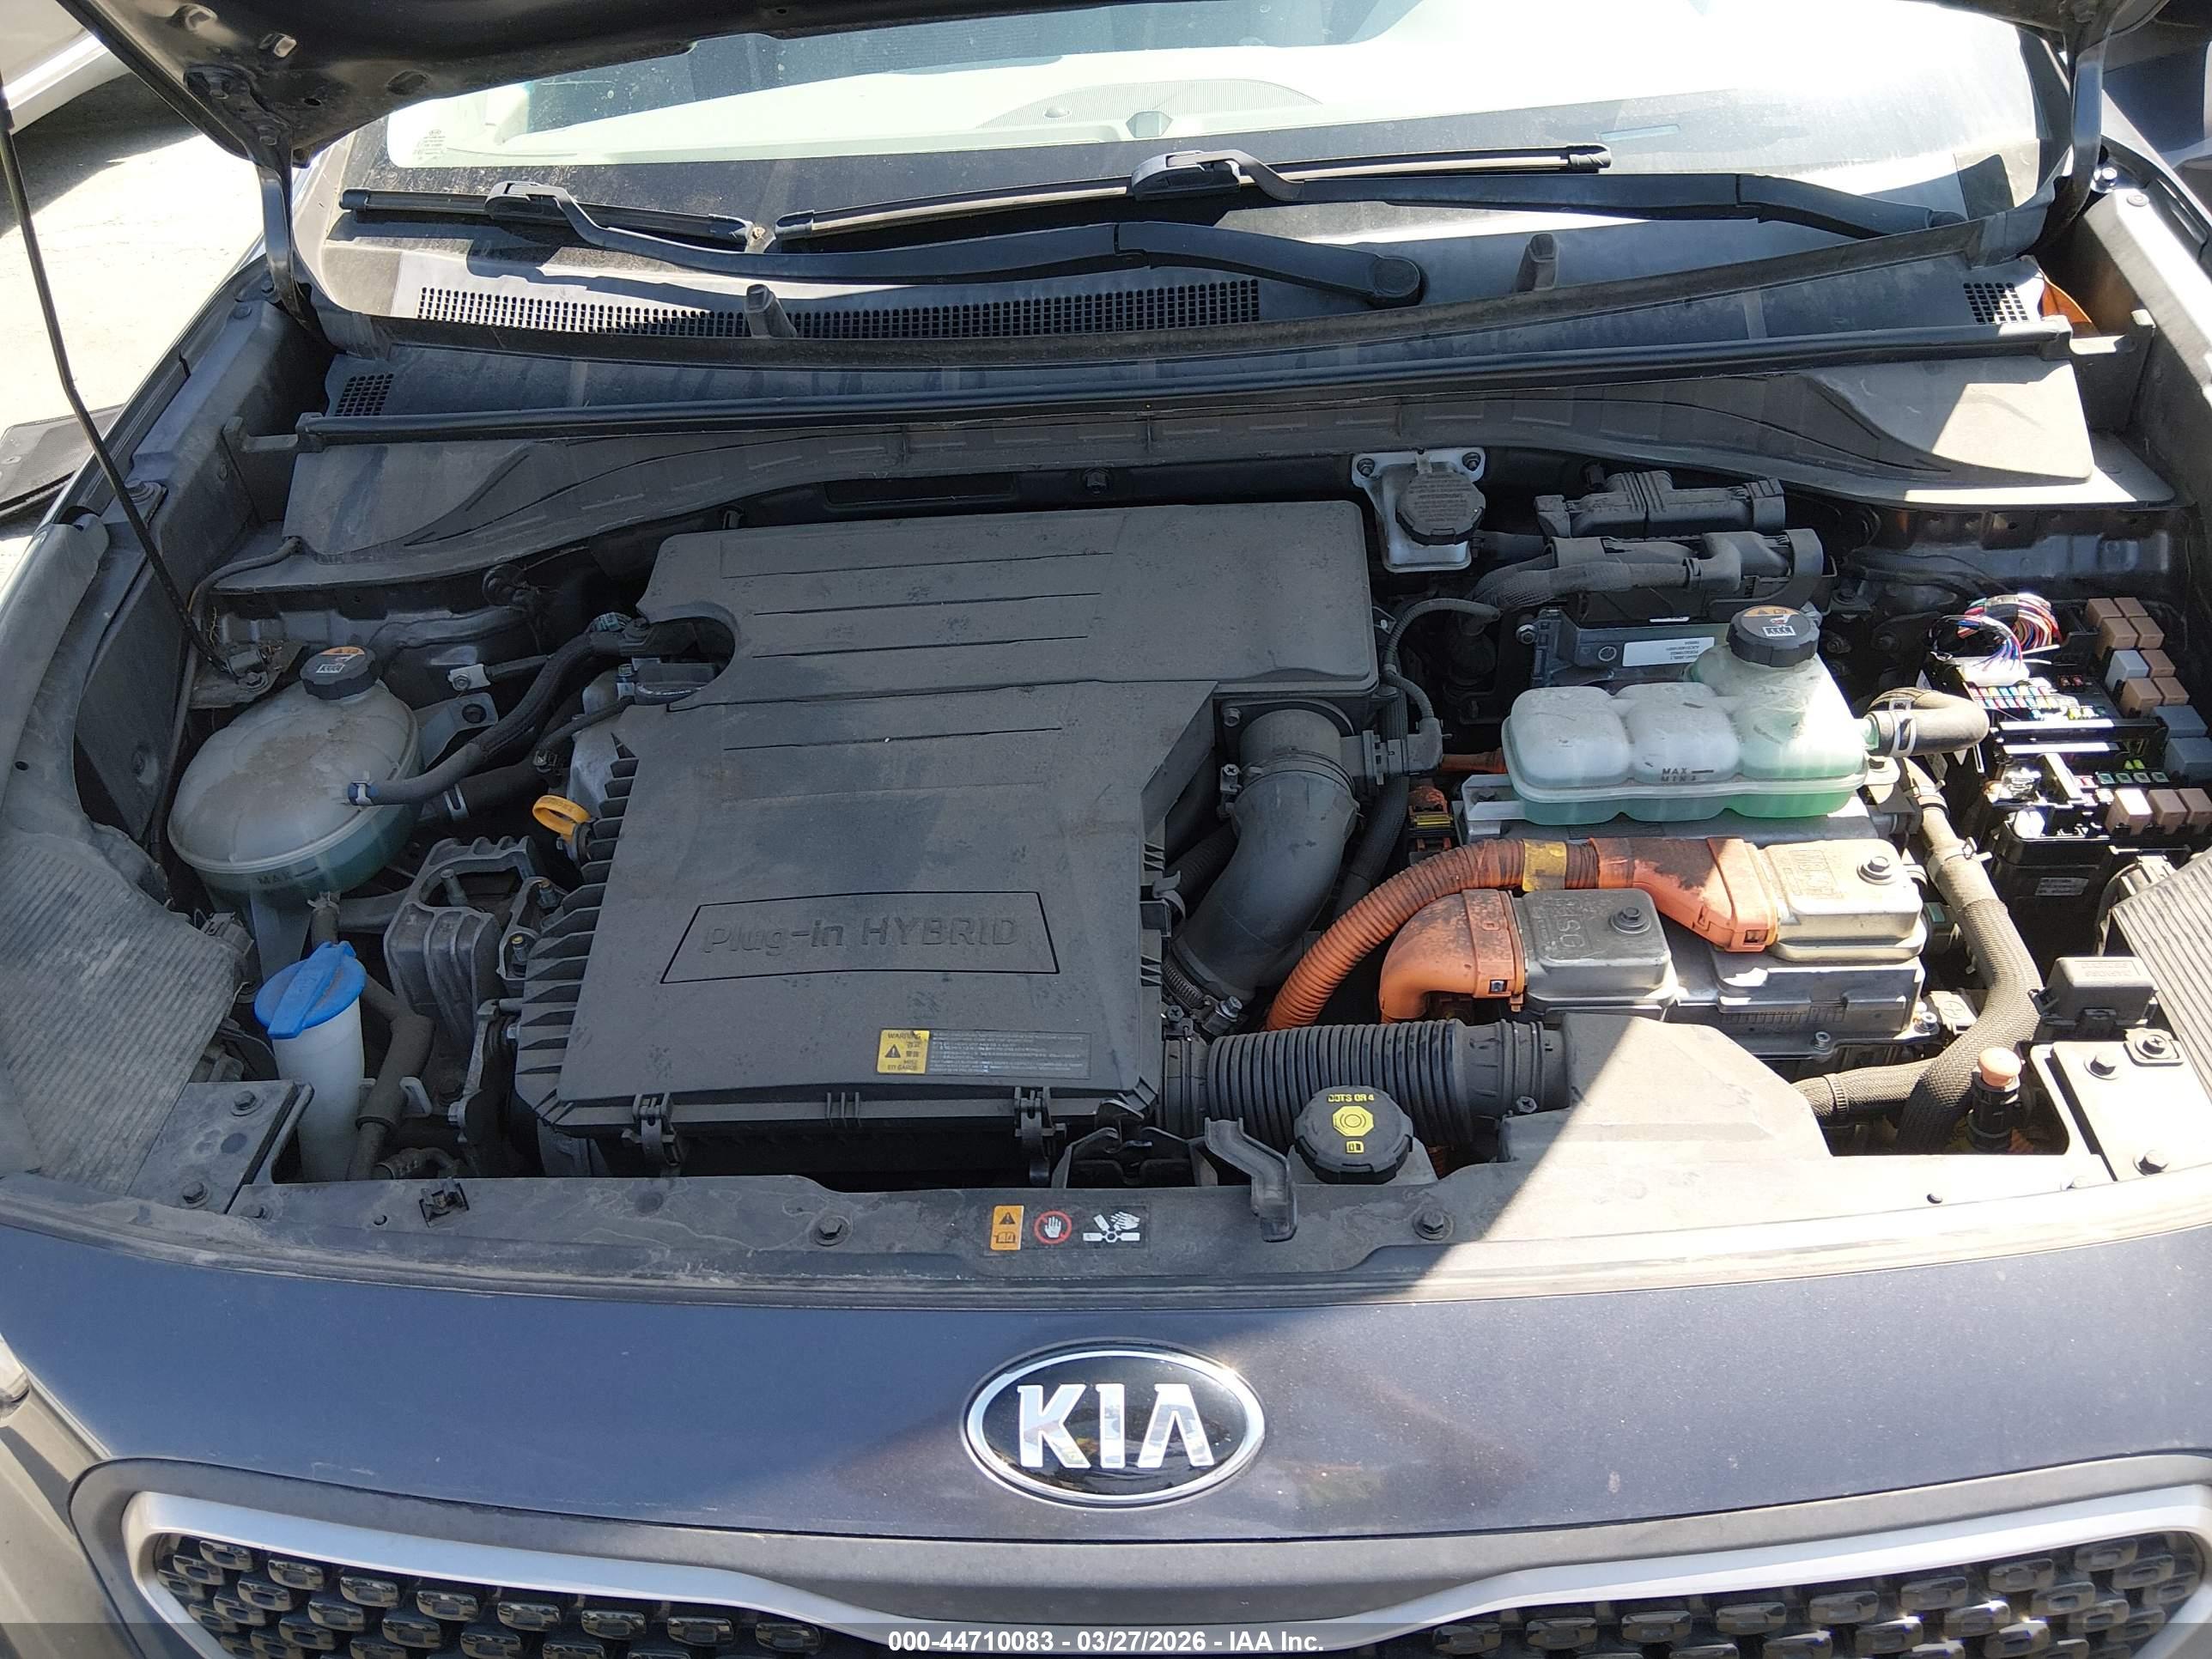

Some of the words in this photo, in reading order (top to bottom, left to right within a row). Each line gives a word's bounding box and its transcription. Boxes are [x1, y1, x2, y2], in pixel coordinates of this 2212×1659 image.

[702, 919, 845, 957] Plug-in
[860, 916, 1019, 946] HYBRID
[1353, 1093, 1367, 1103] OR
[1017, 1382, 1215, 1468] KIA
